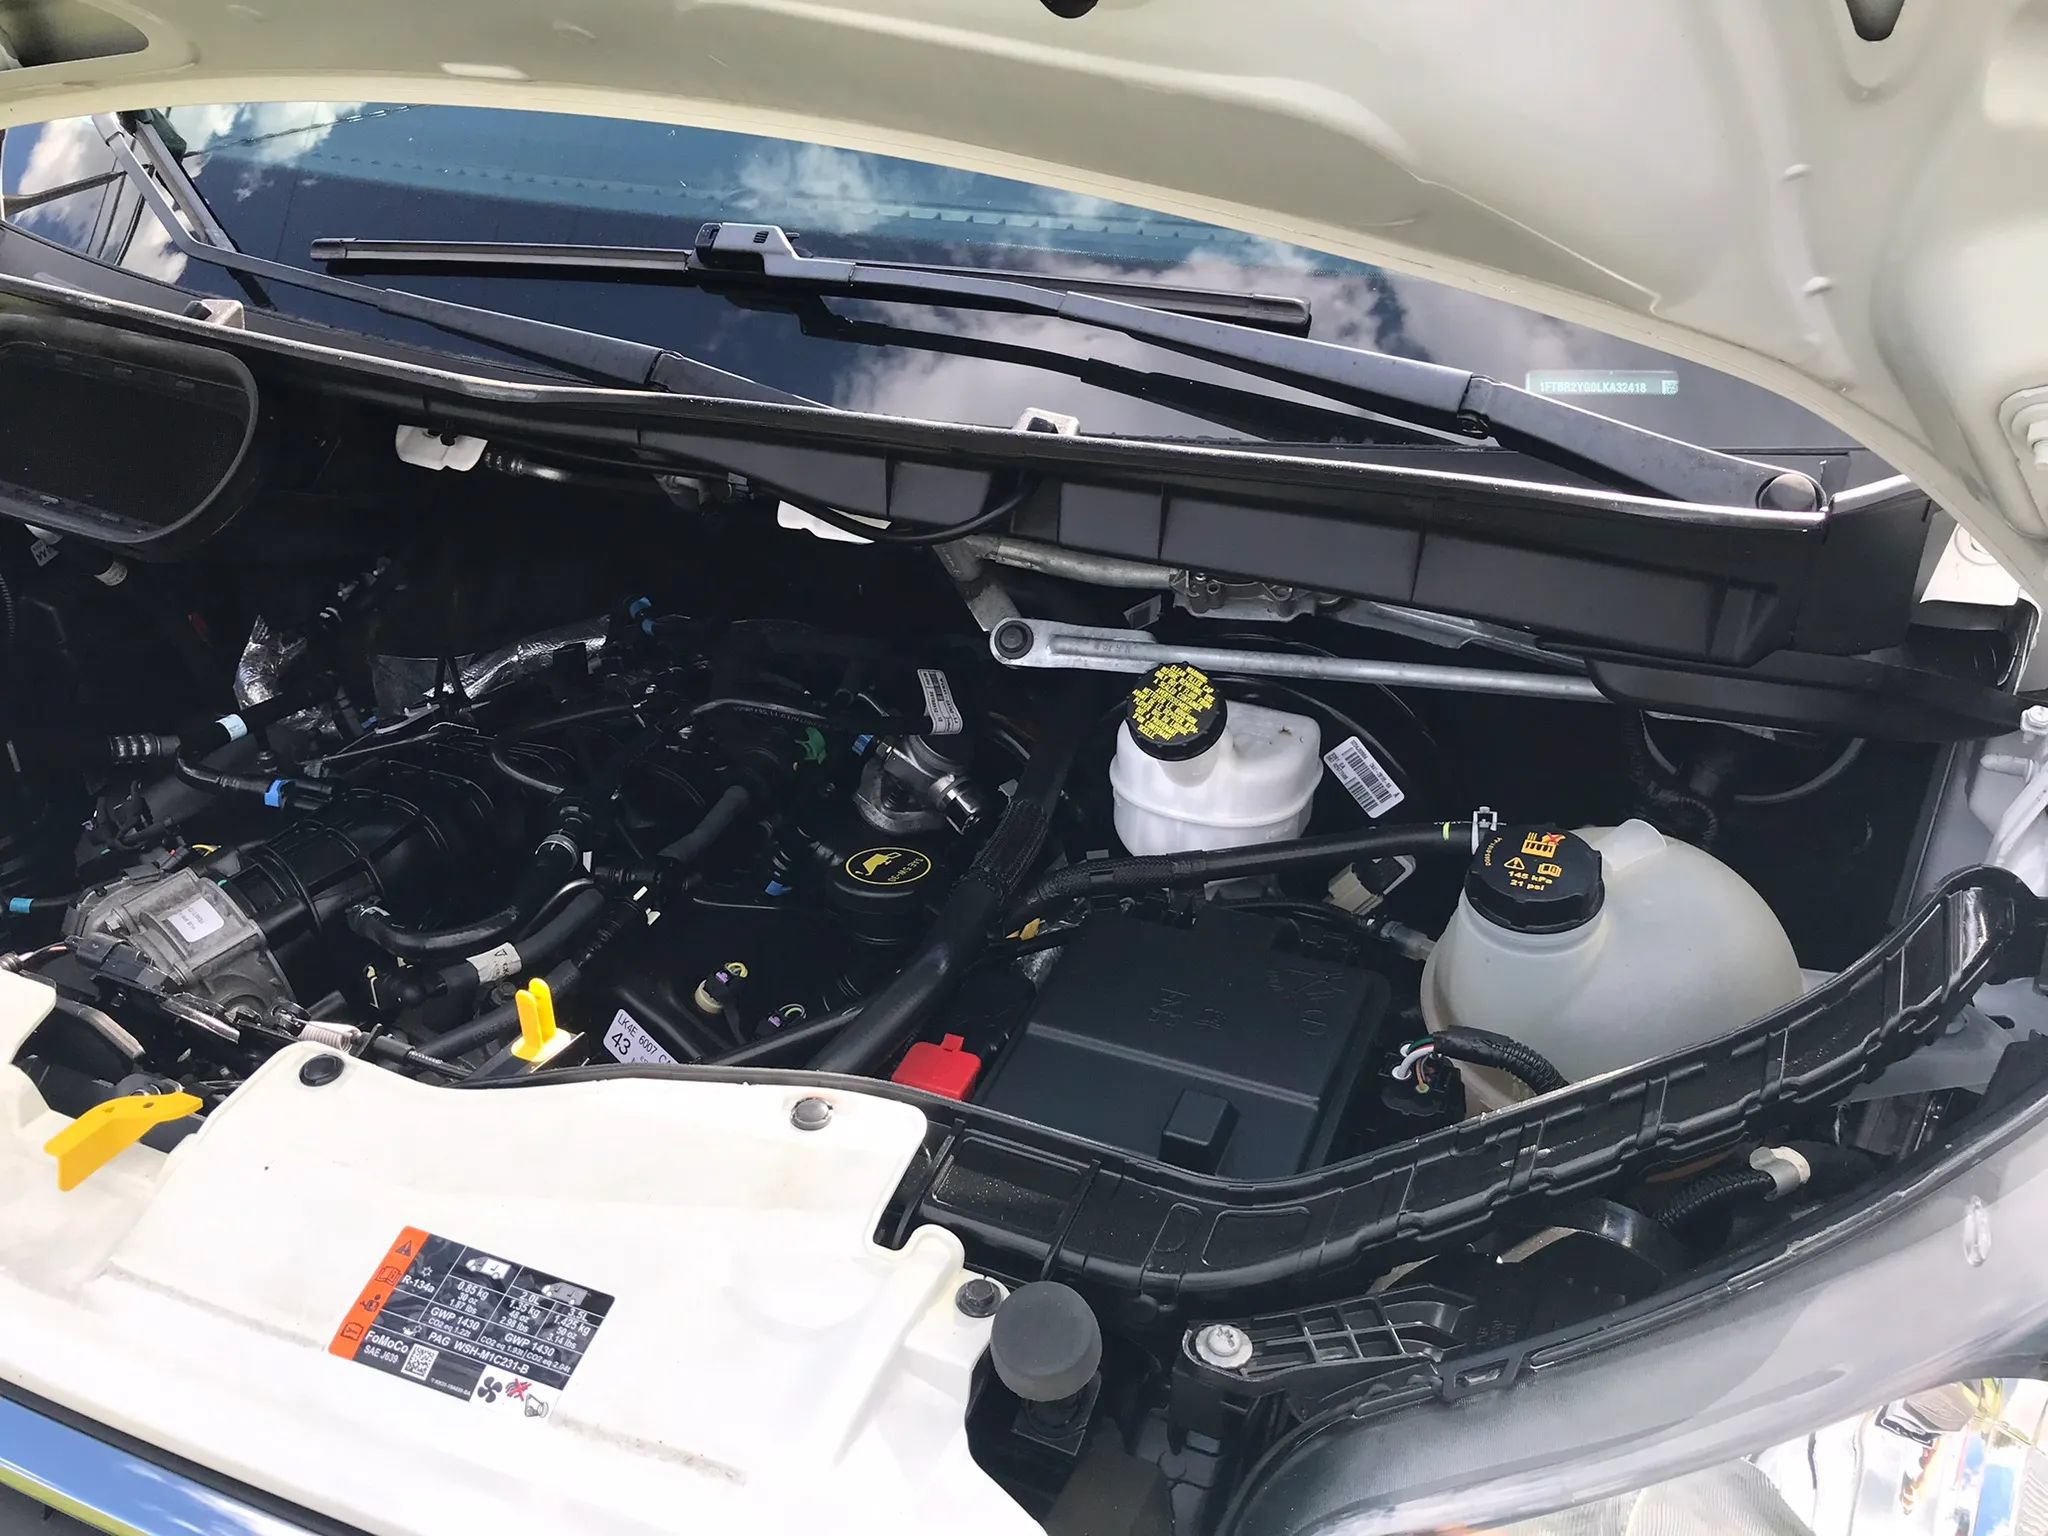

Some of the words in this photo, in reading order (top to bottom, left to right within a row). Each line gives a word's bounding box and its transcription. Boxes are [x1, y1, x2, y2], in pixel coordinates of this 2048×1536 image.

[1508, 871, 1529, 879] 145
[1531, 875, 1552, 884] kPa
[618, 1013, 638, 1037] LK4E
[639, 1036, 657, 1055] 6007
[612, 1033, 631, 1055] 43
[402, 1275, 435, 1293] R-134a
[457, 1281, 477, 1295] 0.85
[477, 1288, 489, 1301] kg
[458, 1292, 468, 1301] 30
[468, 1297, 478, 1305] oz
[520, 1291, 539, 1305] 2.0L
[450, 1299, 465, 1310] 1.87
[465, 1304, 477, 1314] lbs
[509, 1300, 529, 1312] 1.35
[528, 1305, 540, 1319] kg
[568, 1308, 588, 1321] 3.5L
[428, 1318, 444, 1328] CO2
[444, 1324, 453, 1332] eq
[431, 1307, 456, 1321] GWP
[457, 1316, 480, 1330] 1430
[500, 1316, 516, 1328] 2.98
[516, 1321, 529, 1332] lbs
[519, 1315, 530, 1323] oz
[553, 1315, 578, 1329] 1.425
[578, 1323, 590, 1336] kg
[365, 1331, 409, 1354] FoMoCo
[480, 1336, 496, 1346] CO2
[547, 1333, 563, 1345] 3.14
[564, 1338, 576, 1349] lbs
[567, 1331, 577, 1339] oz
[505, 1333, 530, 1347] GWP
[532, 1342, 555, 1356] 1430
[364, 1345, 381, 1358] SAE
[380, 1351, 399, 1363] J639
[428, 1332, 451, 1346] PAG
[454, 1341, 529, 1374] WSH-M1C231-B
[526, 1352, 542, 1362] CO2
